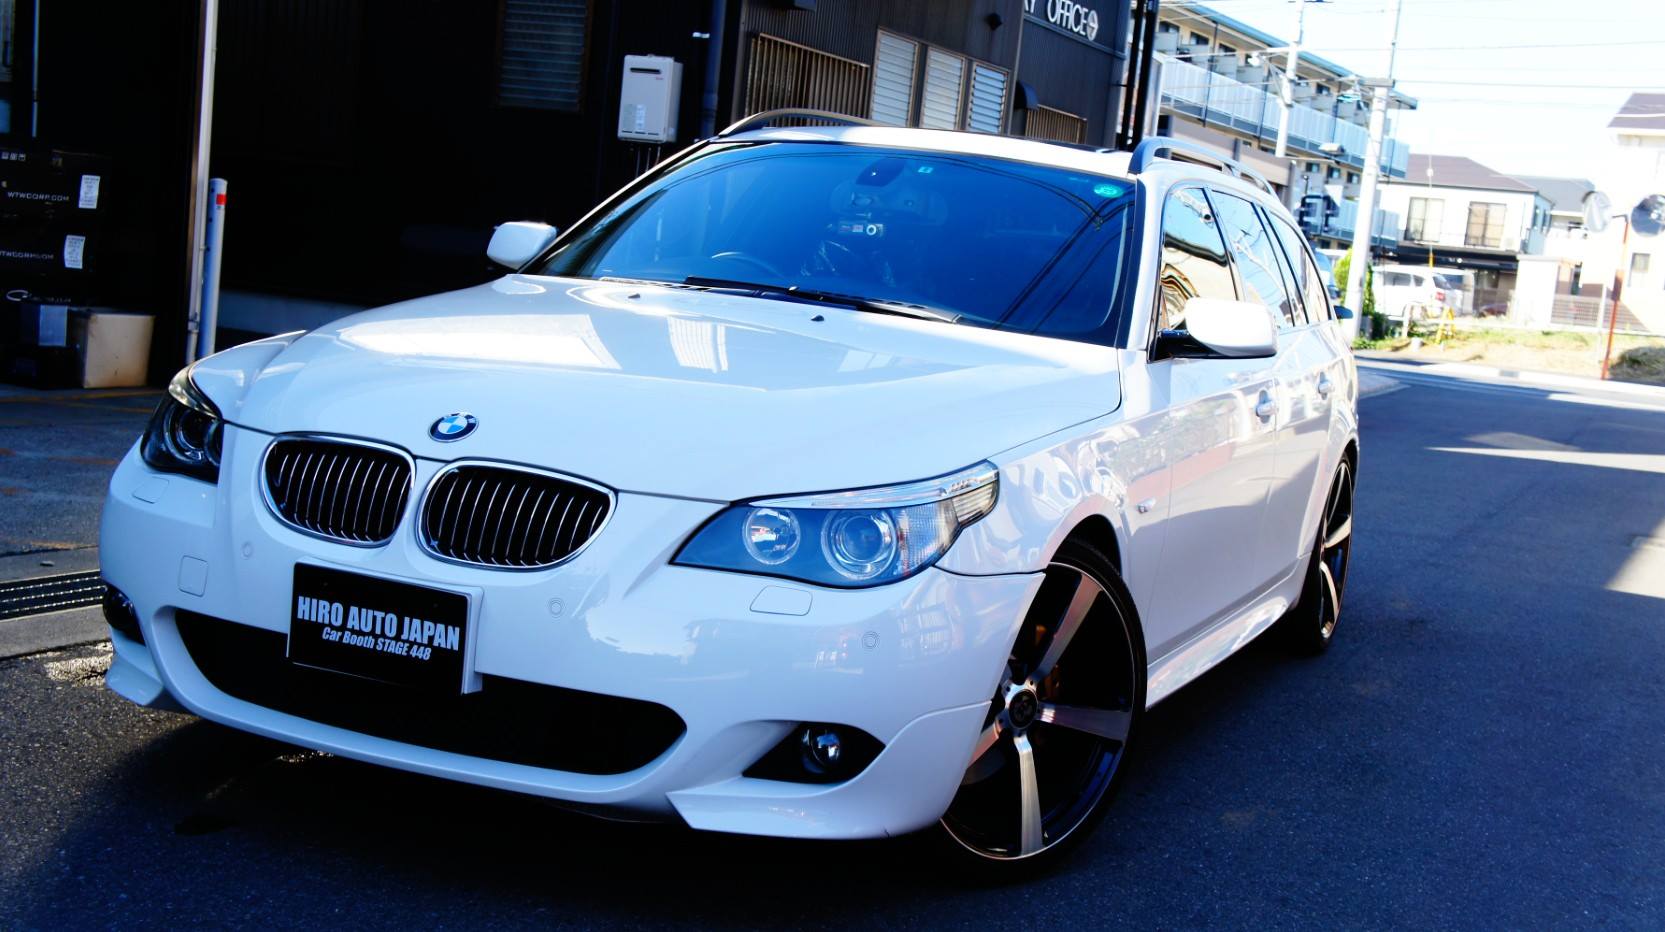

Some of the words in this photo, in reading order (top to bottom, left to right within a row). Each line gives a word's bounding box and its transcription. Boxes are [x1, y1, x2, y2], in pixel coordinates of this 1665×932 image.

[1047, 0, 1088, 35] OFFICE
[297, 595, 344, 627] HIRO
[346, 605, 398, 638] AUTO
[400, 616, 460, 651] JAPAN
[322, 626, 342, 643] Car
[342, 630, 375, 649] Booth
[375, 637, 409, 657] STAGE
[409, 644, 432, 661] 448
